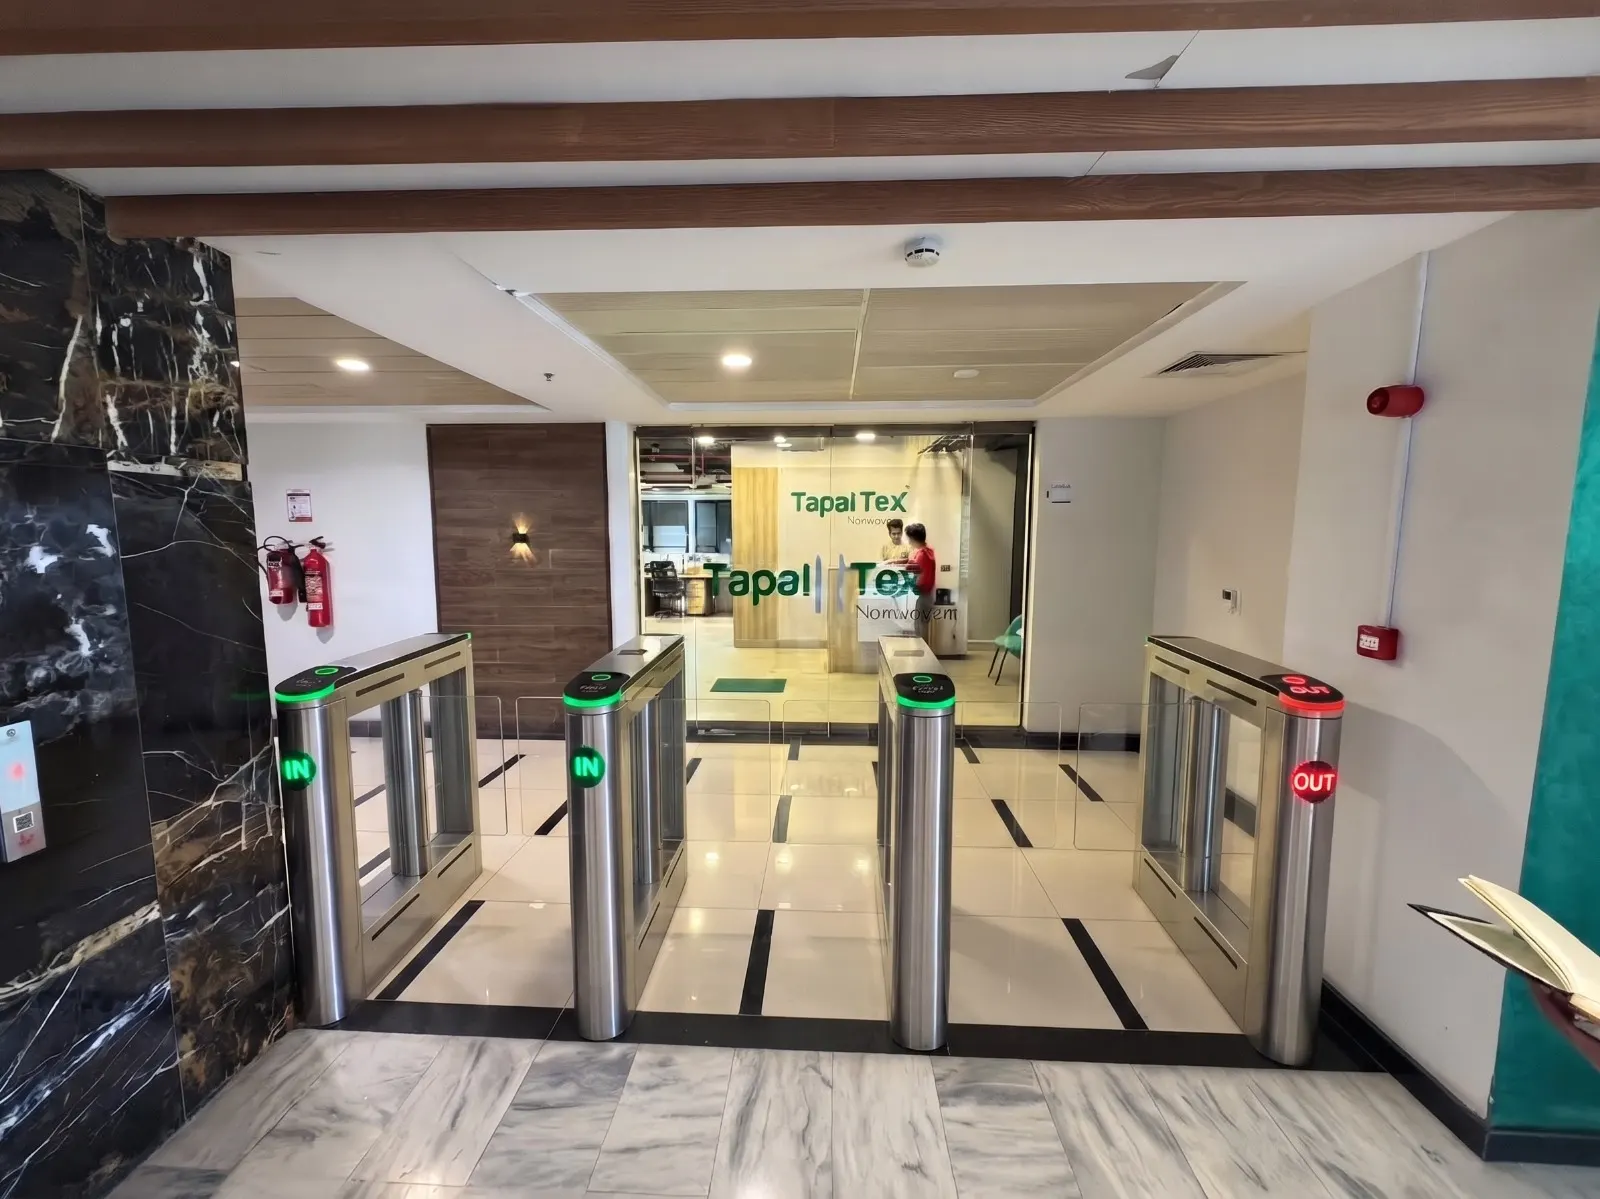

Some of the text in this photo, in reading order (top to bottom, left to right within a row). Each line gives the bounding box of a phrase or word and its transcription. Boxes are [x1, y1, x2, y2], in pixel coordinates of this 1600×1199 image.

[790, 491, 908, 518] Tapal Tex
[703, 562, 922, 607] Tapal Tex
[284, 758, 310, 780] IN
[574, 756, 599, 777] IN
[1293, 772, 1336, 792] OUT
